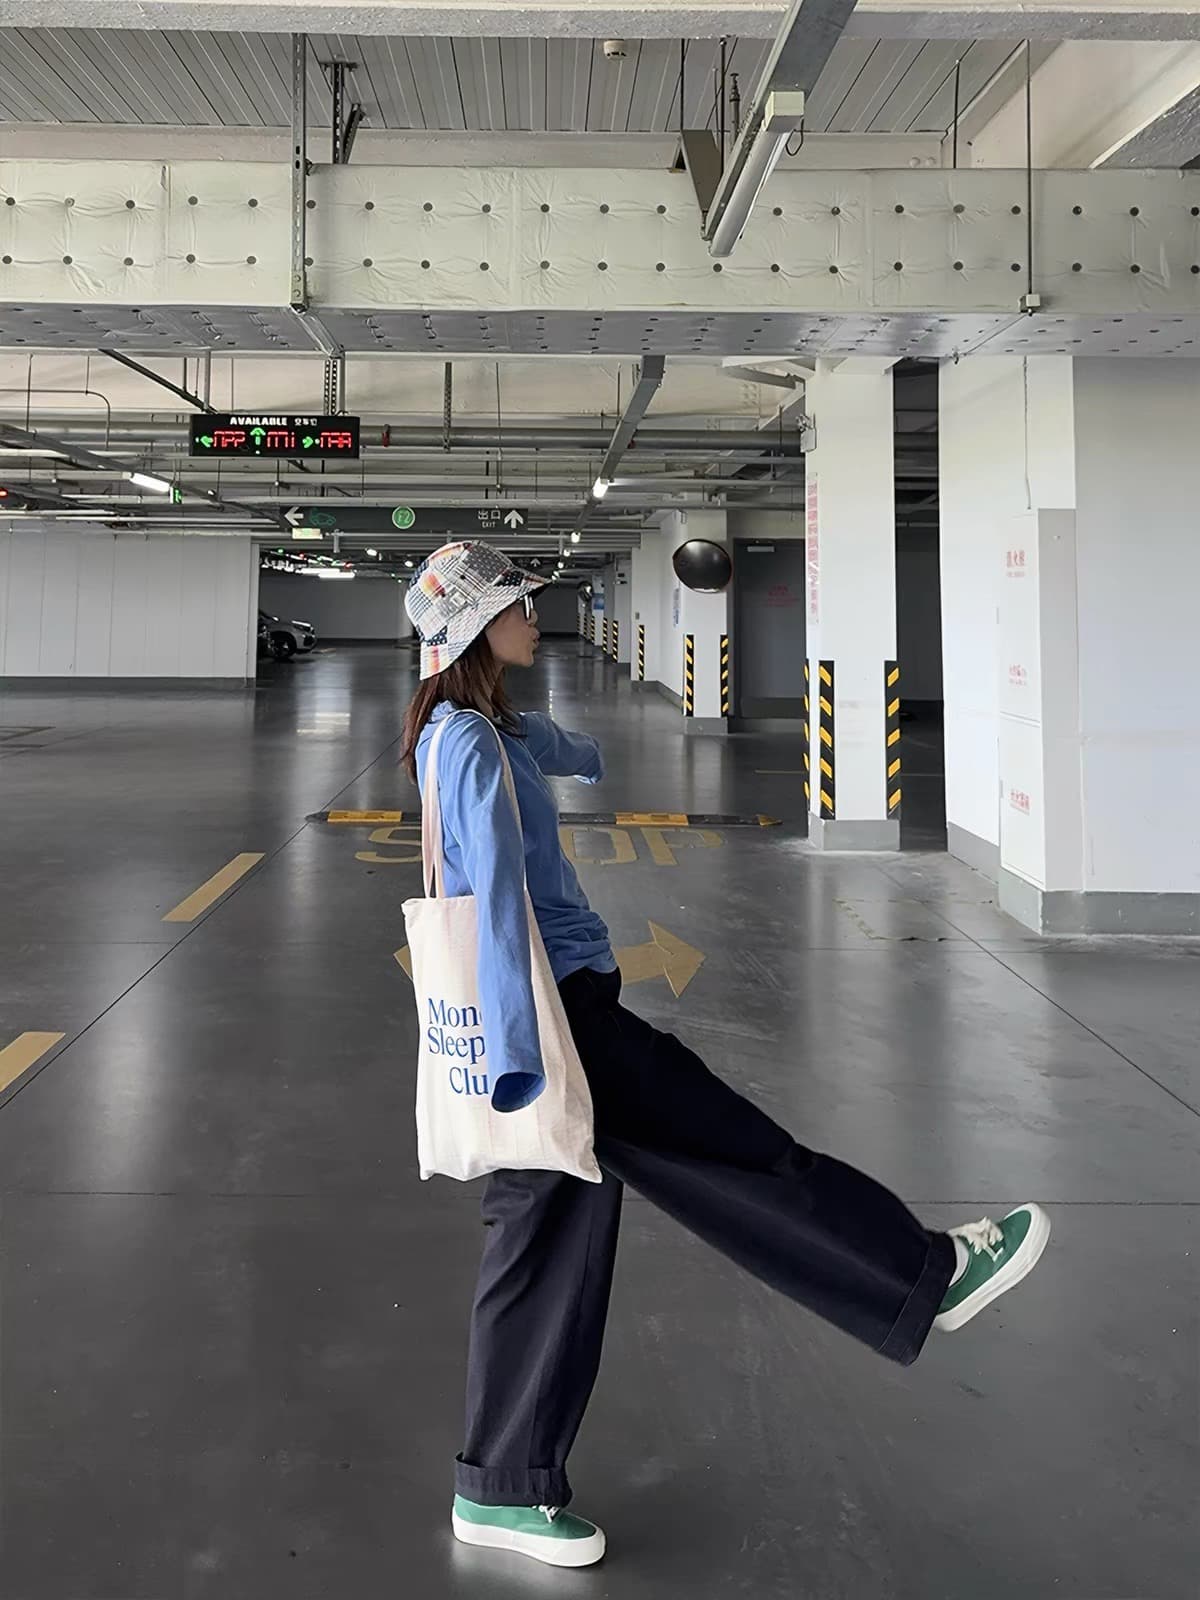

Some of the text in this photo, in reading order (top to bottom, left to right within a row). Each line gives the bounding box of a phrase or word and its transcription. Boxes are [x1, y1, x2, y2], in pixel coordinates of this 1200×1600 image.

[230, 416, 287, 426] AVAILABLE
[355, 825, 727, 867] SOP
[428, 998, 482, 1027] Mon
[427, 1026, 486, 1065] Sleep
[449, 1067, 489, 1095] Clu
